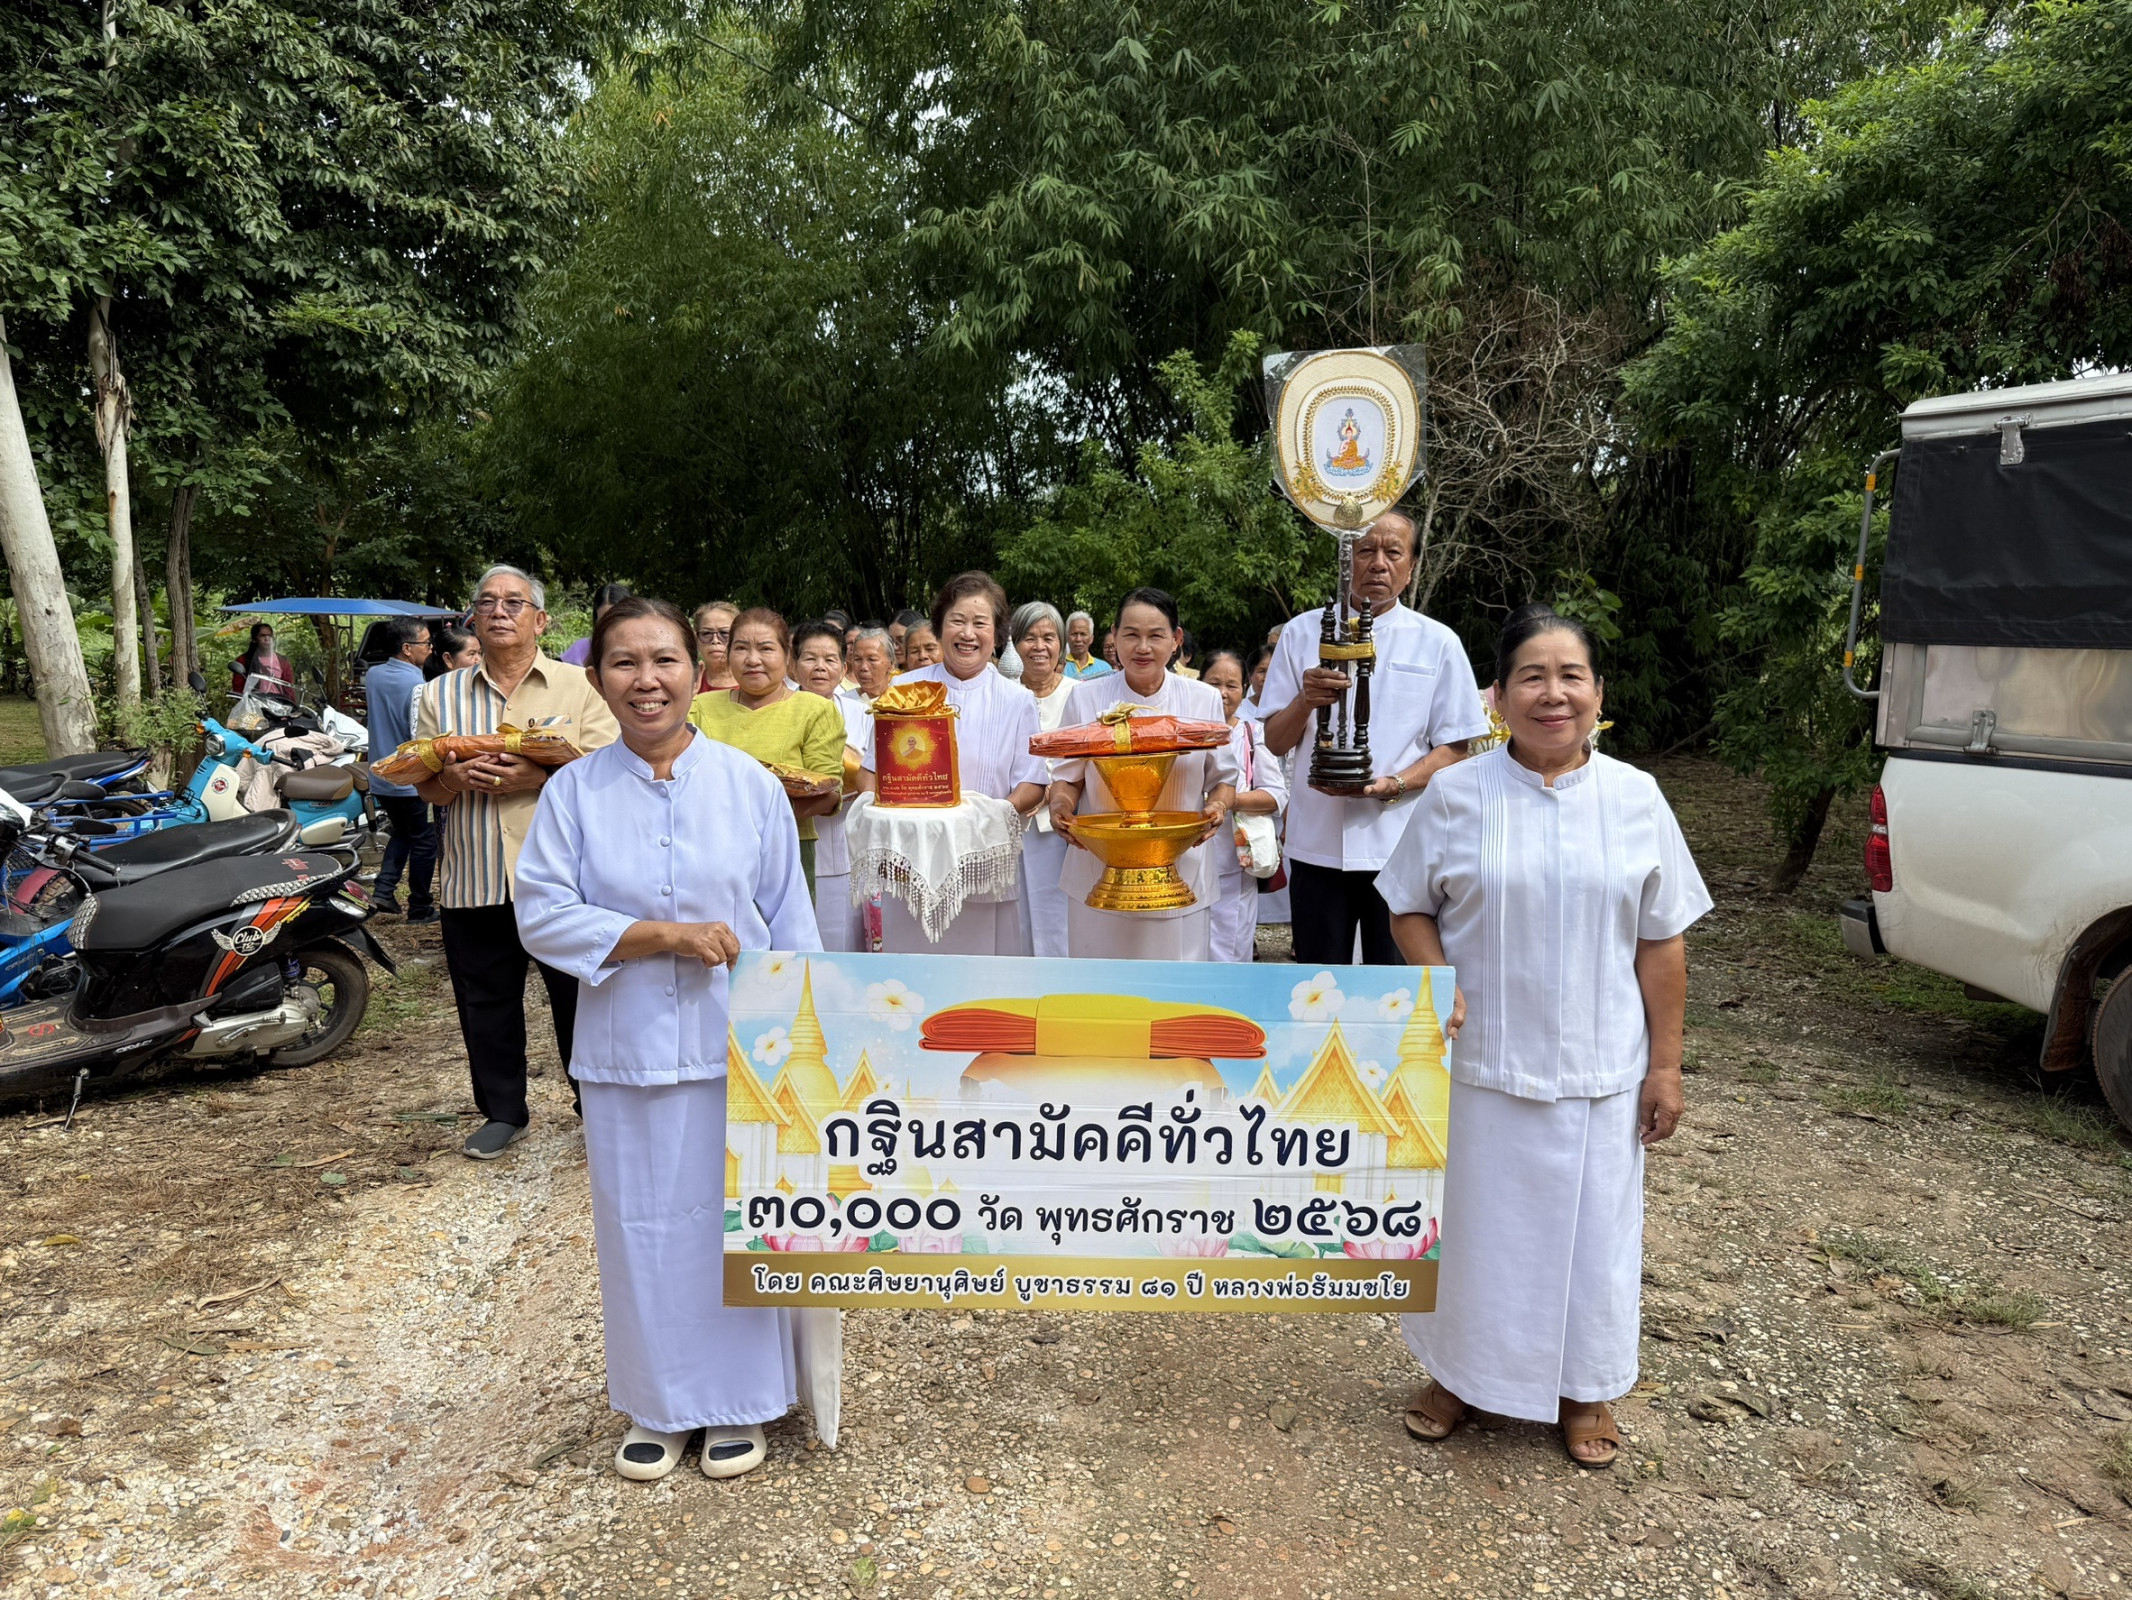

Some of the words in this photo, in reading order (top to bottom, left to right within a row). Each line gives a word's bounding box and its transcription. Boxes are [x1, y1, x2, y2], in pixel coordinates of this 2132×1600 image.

[235, 930, 262, 945] Club
[825, 1089, 1350, 1176] กฐินสามัคคีทั่วไทย
[749, 1196, 961, 1237] ๓๐,๐๐๐
[977, 1193, 1023, 1231] วัด
[1035, 1196, 1235, 1246] พุทธศักราช
[1252, 1197, 1422, 1237] ๒๕๖๘
[753, 1266, 799, 1291] โดย
[811, 1268, 1004, 1300] คณะศิษยานุศิษย์
[1015, 1278, 1130, 1301] บูชาธรรม
[1141, 1279, 1176, 1297] ๘๑
[1186, 1272, 1203, 1295] ปี
[1213, 1274, 1407, 1298] หลวงพ่อธัมมชโย
